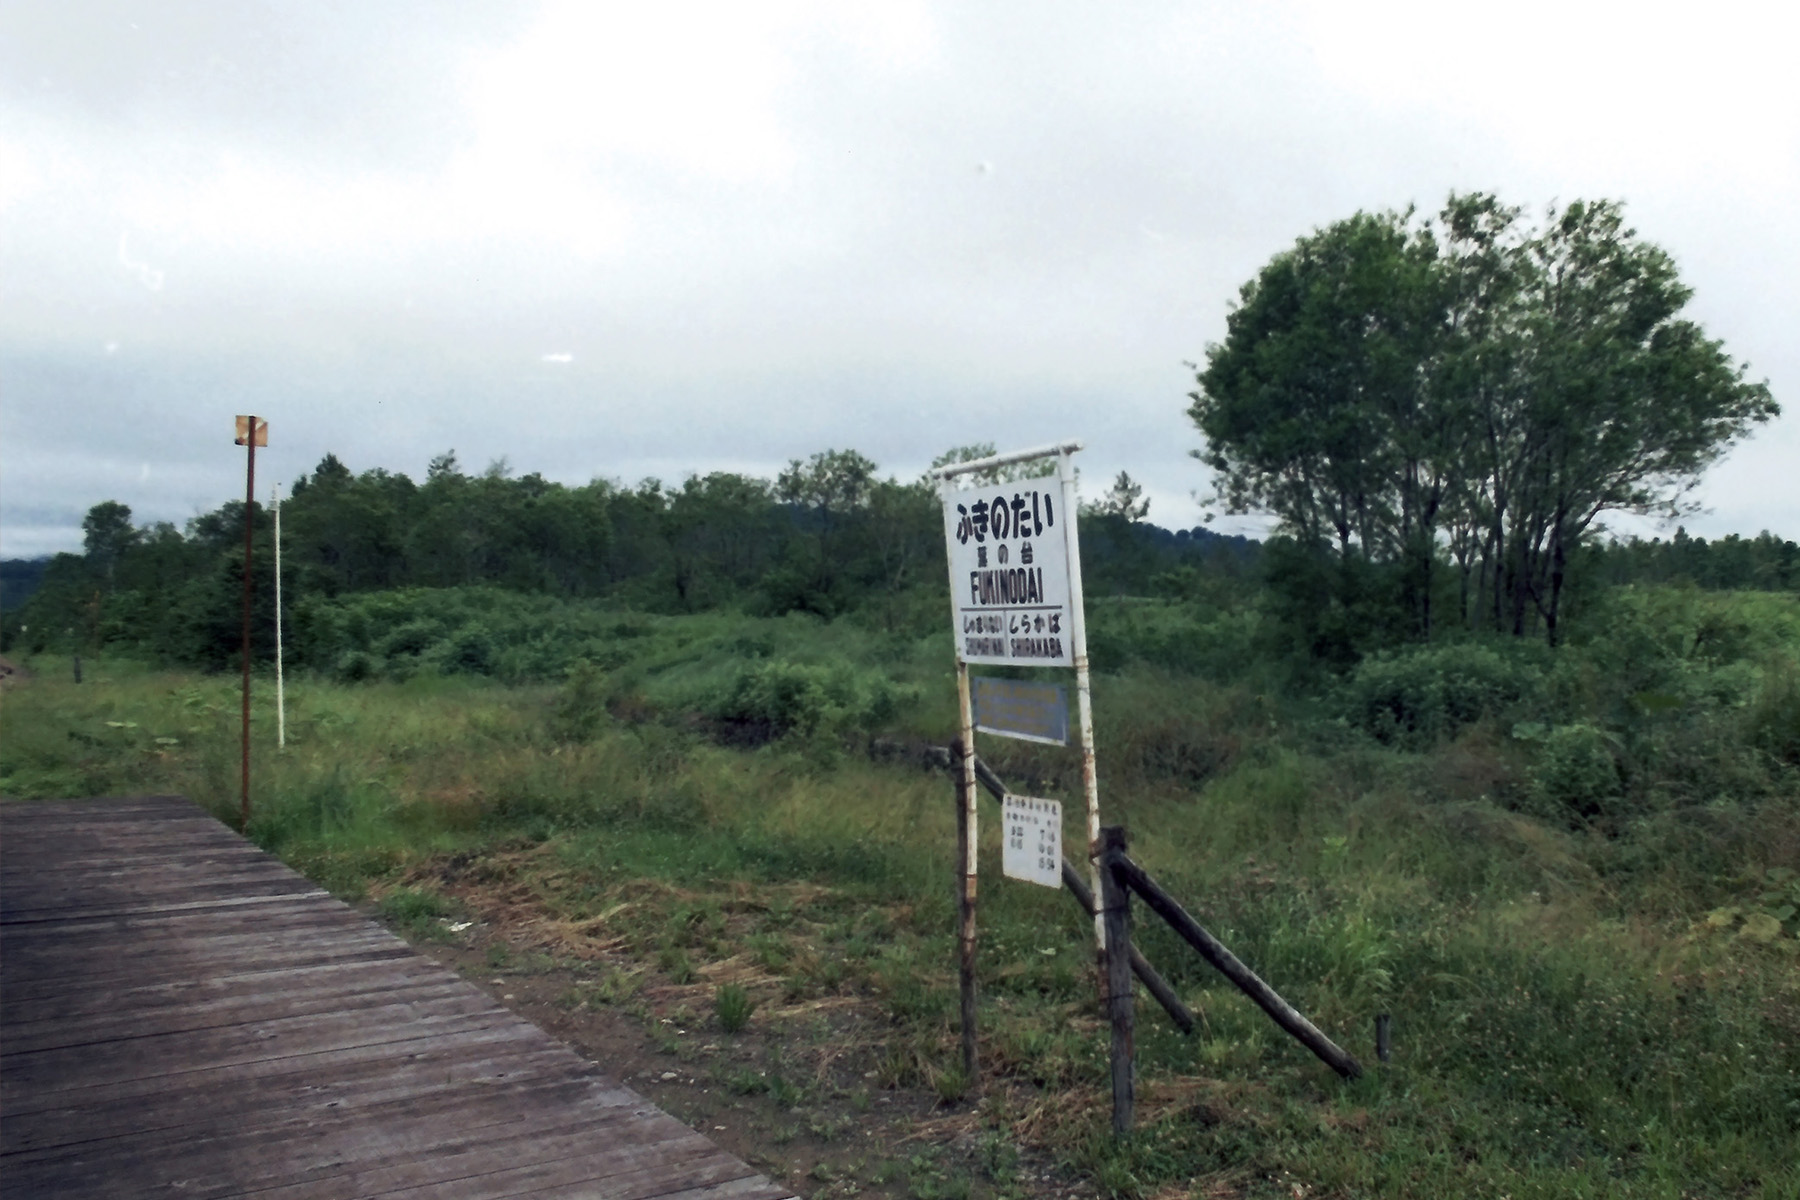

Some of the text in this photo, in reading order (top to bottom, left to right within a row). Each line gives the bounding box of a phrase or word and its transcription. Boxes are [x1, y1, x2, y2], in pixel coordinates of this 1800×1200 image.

[957, 491, 1054, 545] ふきのだい
[977, 541, 1033, 568] の台
[970, 567, 1043, 605] FUKINODAI
[1009, 612, 1062, 634] しらかば
